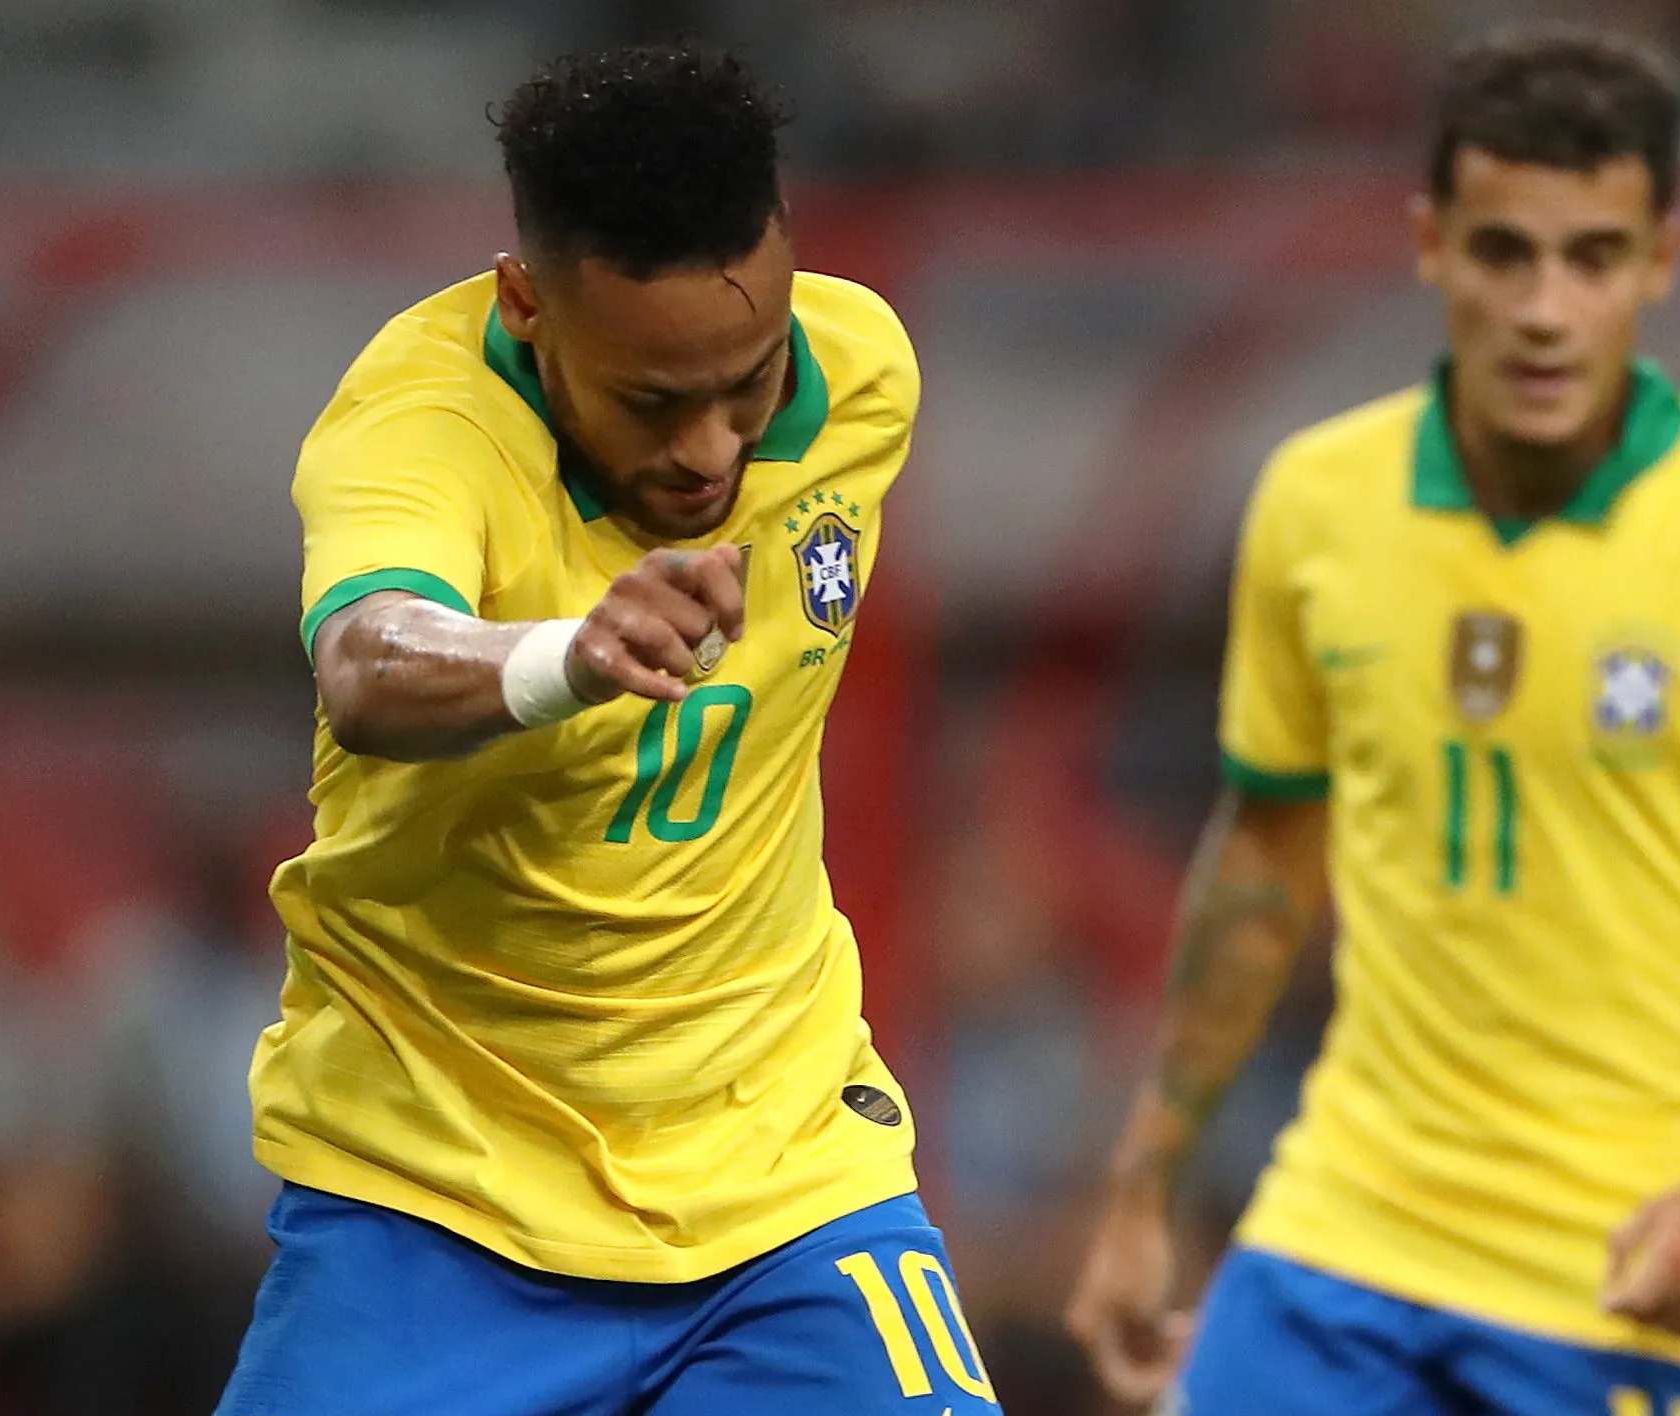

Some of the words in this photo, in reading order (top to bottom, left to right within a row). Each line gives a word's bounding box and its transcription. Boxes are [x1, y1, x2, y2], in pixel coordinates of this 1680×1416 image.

[606, 684, 753, 843] 10
[1448, 743, 1517, 891] 11
[834, 1250, 999, 1405] 10
